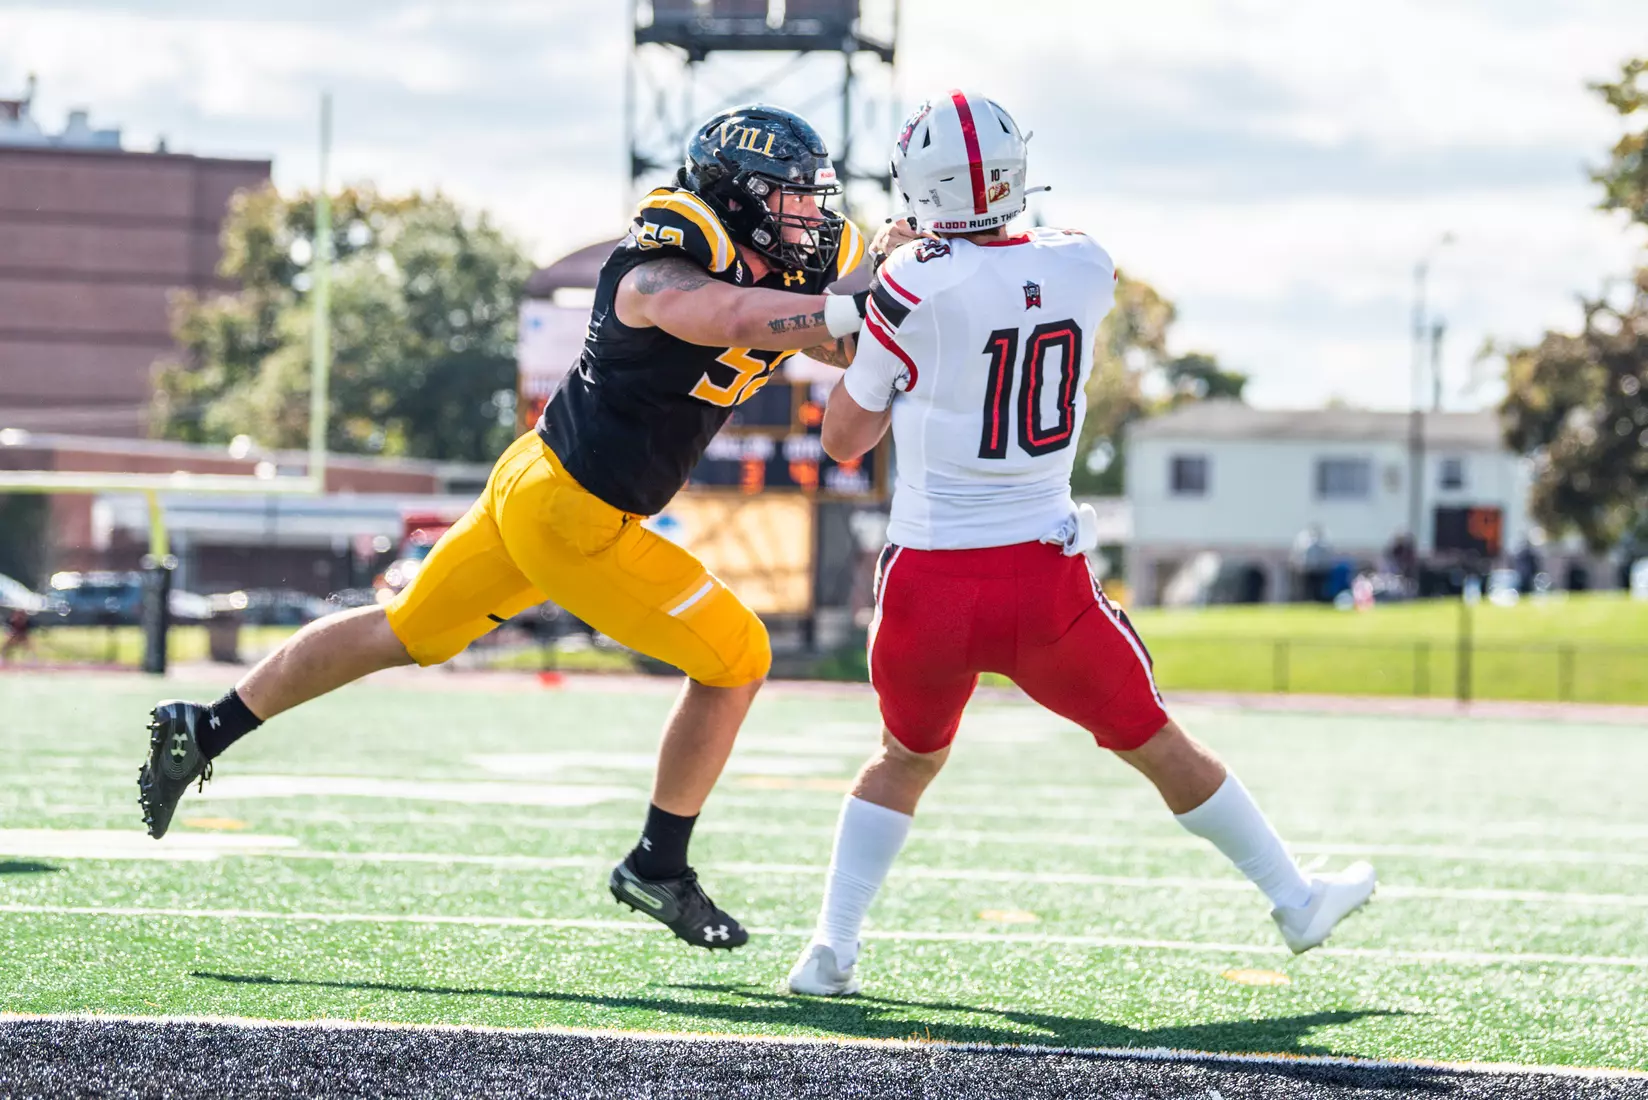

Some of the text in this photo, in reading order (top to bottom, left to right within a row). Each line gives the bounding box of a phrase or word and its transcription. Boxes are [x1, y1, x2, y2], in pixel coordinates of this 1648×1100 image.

[990, 168, 1000, 181] 10
[933, 221, 967, 229] BLOOD
[969, 216, 998, 228] RUNS
[978, 318, 1083, 459] 10
